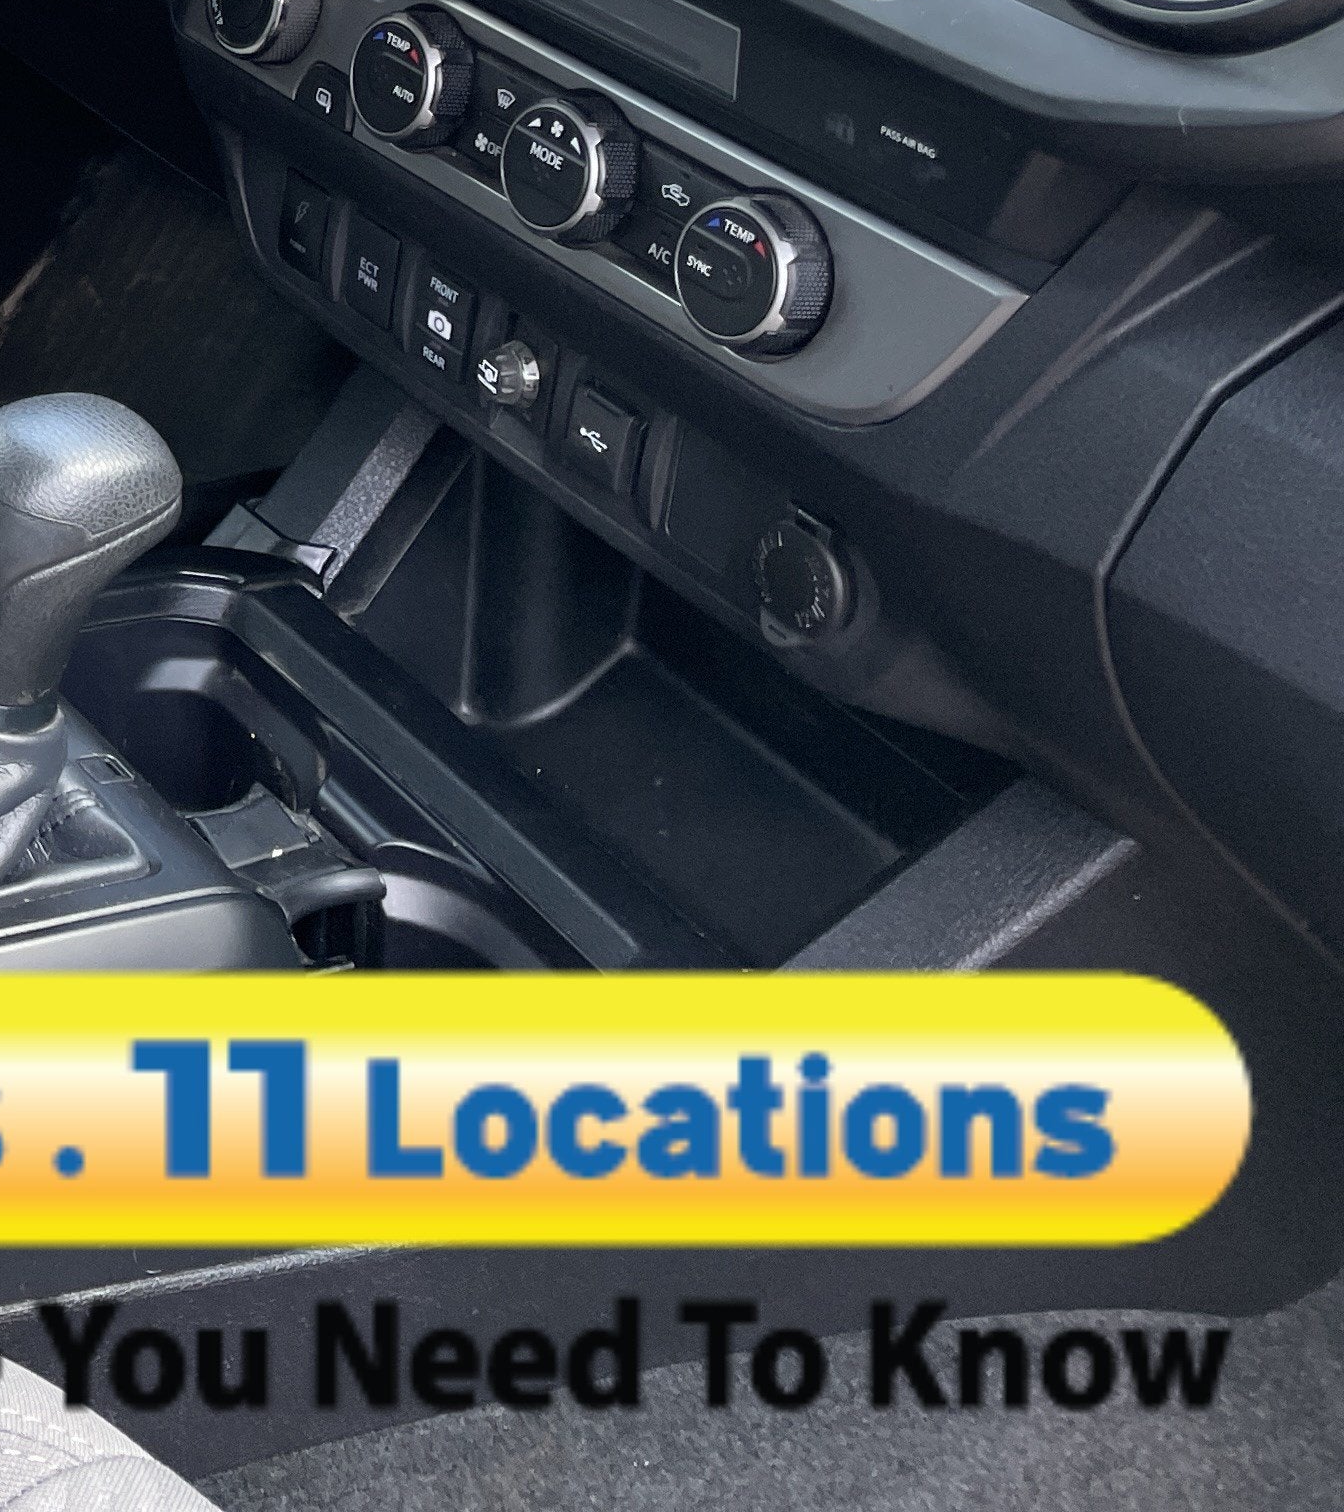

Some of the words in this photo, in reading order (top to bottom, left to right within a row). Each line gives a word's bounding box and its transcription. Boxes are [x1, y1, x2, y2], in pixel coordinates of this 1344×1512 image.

[386, 32, 412, 53] TEMP
[392, 85, 415, 104] AUTO
[486, 141, 502, 158] OF
[880, 125, 902, 143] PASS
[917, 142, 936, 159] BAG
[529, 141, 564, 171] MODE
[724, 218, 756, 244] TEMP
[648, 242, 672, 265] A/C
[359, 256, 379, 277] ECT
[686, 255, 713, 277] SYNC
[357, 270, 379, 292] PWR
[429, 276, 460, 303] FRONT
[422, 346, 446, 371] REAR
